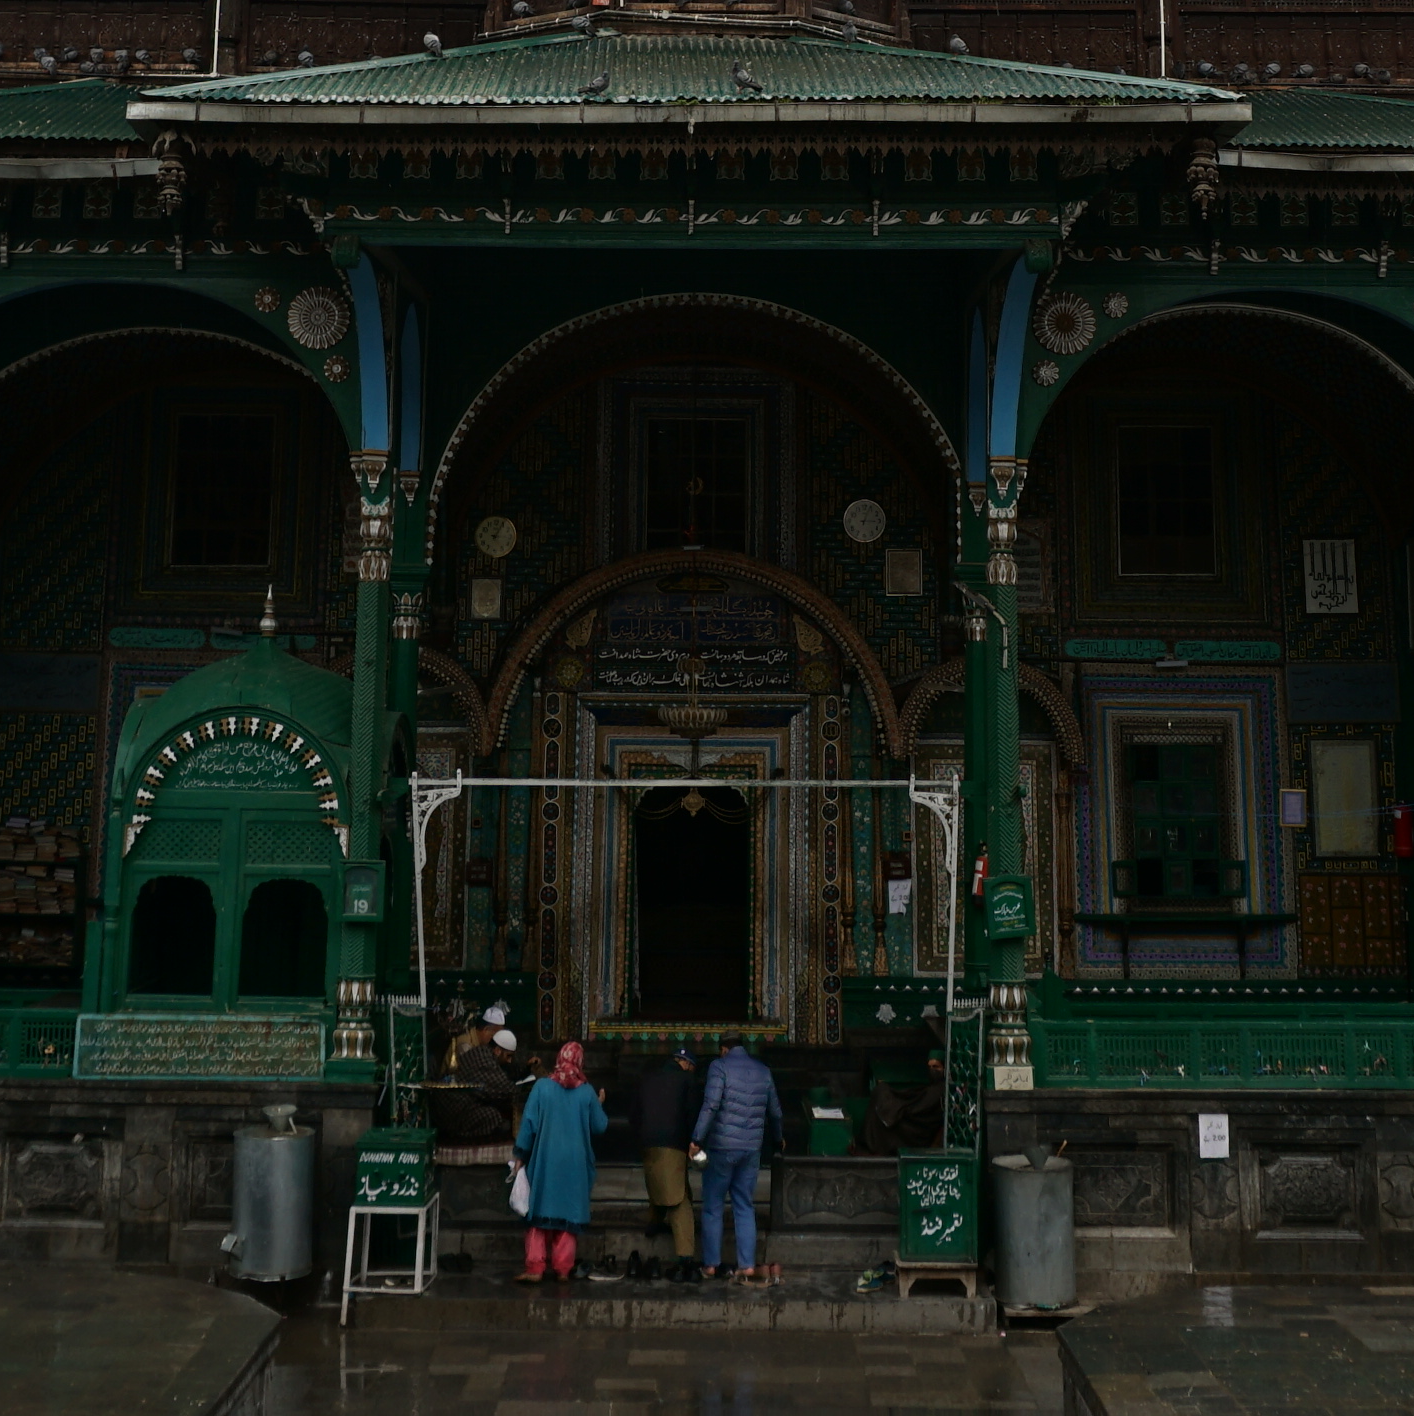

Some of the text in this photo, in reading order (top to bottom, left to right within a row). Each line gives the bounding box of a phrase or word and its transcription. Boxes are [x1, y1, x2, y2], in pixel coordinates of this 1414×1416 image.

[353, 899, 369, 914] 19
[358, 1151, 420, 1165] DONATION FUND
